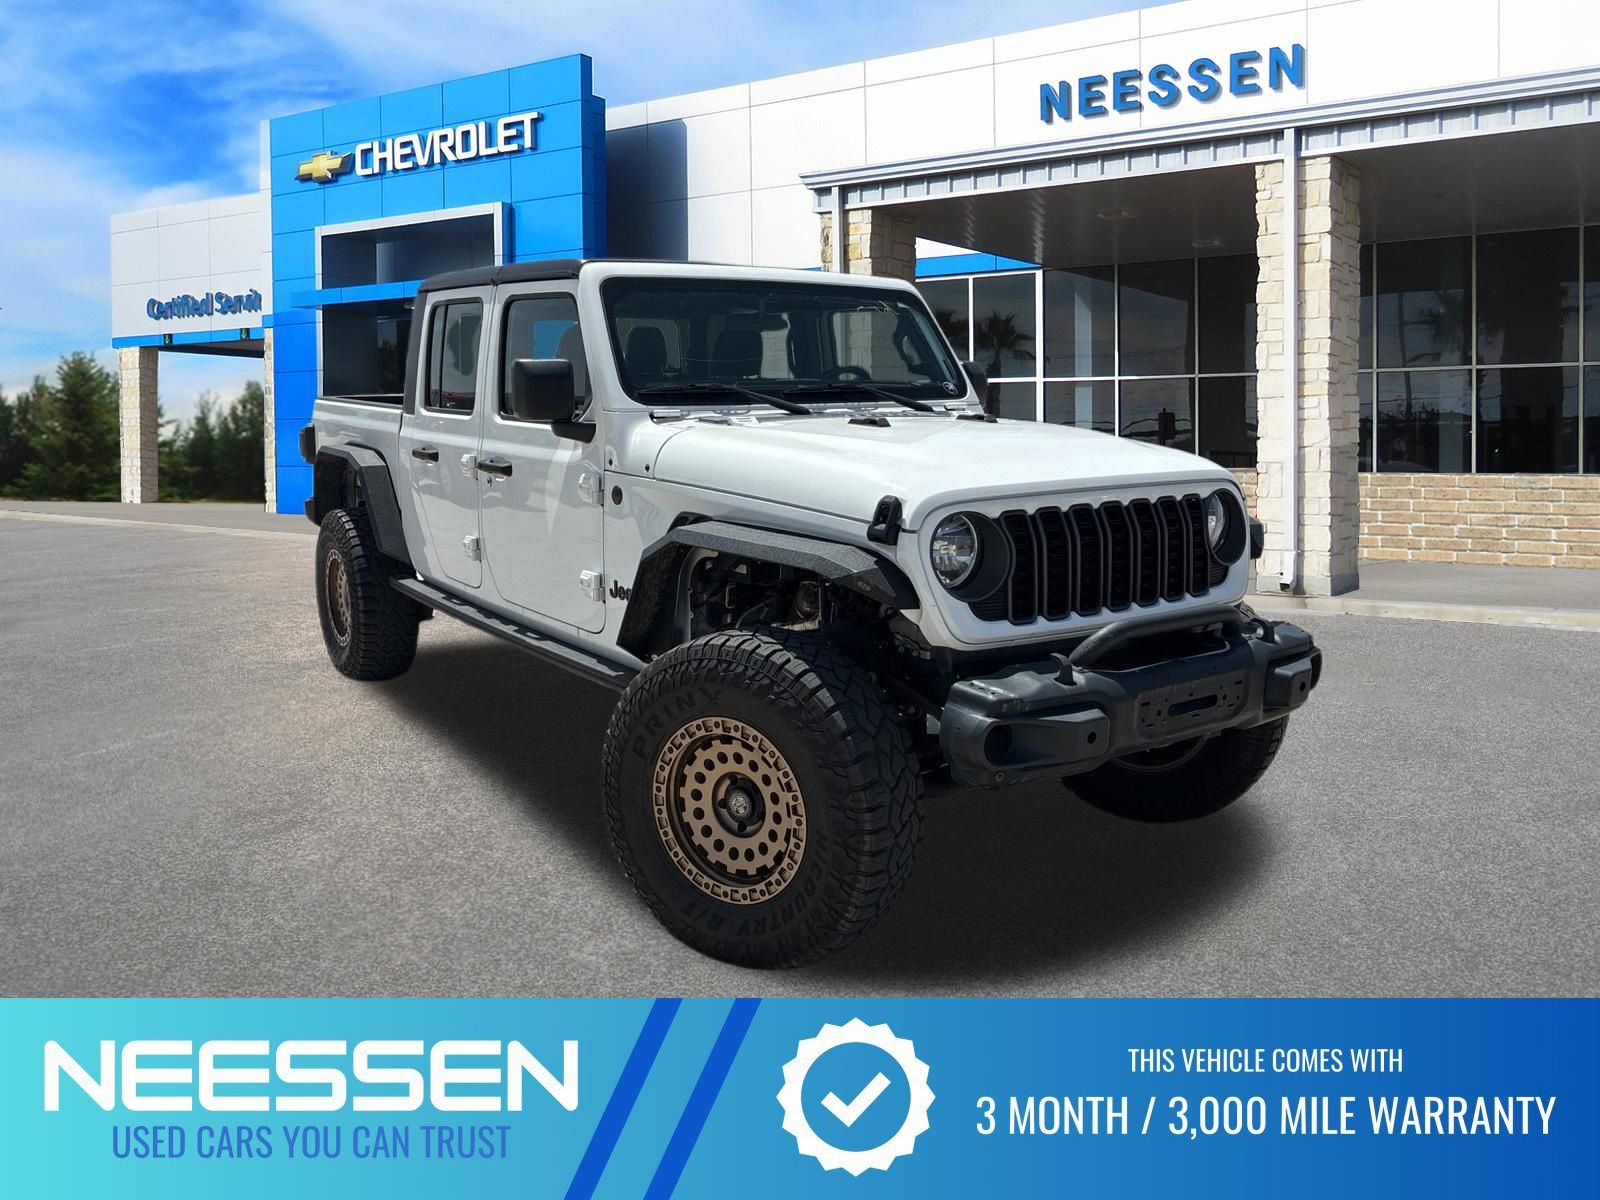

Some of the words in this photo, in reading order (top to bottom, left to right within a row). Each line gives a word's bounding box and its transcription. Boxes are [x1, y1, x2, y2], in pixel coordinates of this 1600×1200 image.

[1040, 43, 1305, 125] NEESSEN
[354, 111, 542, 177] CHEVROLET
[146, 292, 213, 320] Certified
[609, 579, 632, 602] Jee
